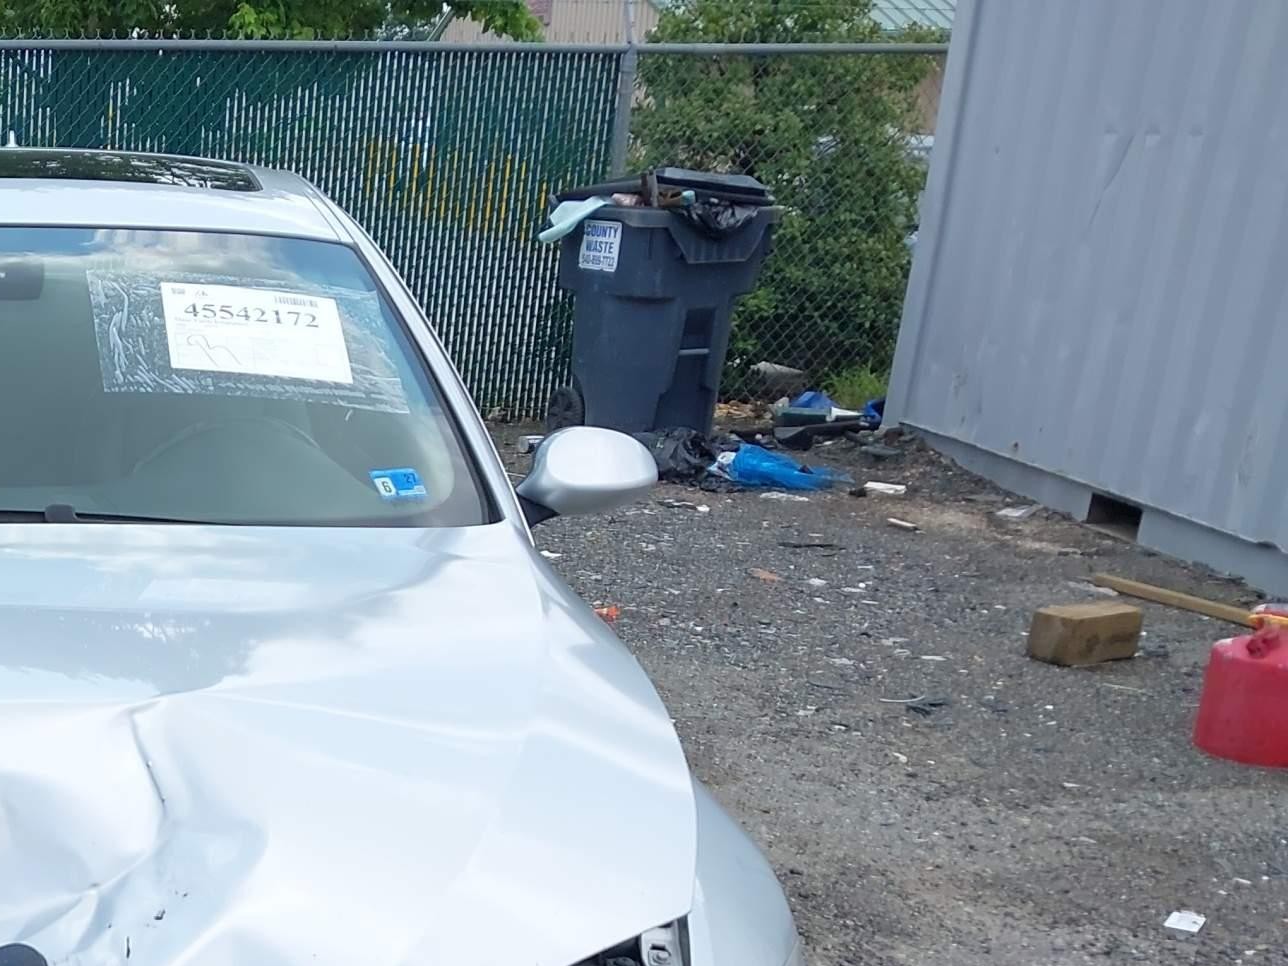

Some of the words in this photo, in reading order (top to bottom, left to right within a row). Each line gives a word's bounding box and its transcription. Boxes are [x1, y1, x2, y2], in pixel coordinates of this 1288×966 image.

[586, 224, 618, 238] COUNTY
[586, 240, 614, 253] WASTE
[183, 302, 320, 328] 45542172
[381, 480, 393, 494] 6
